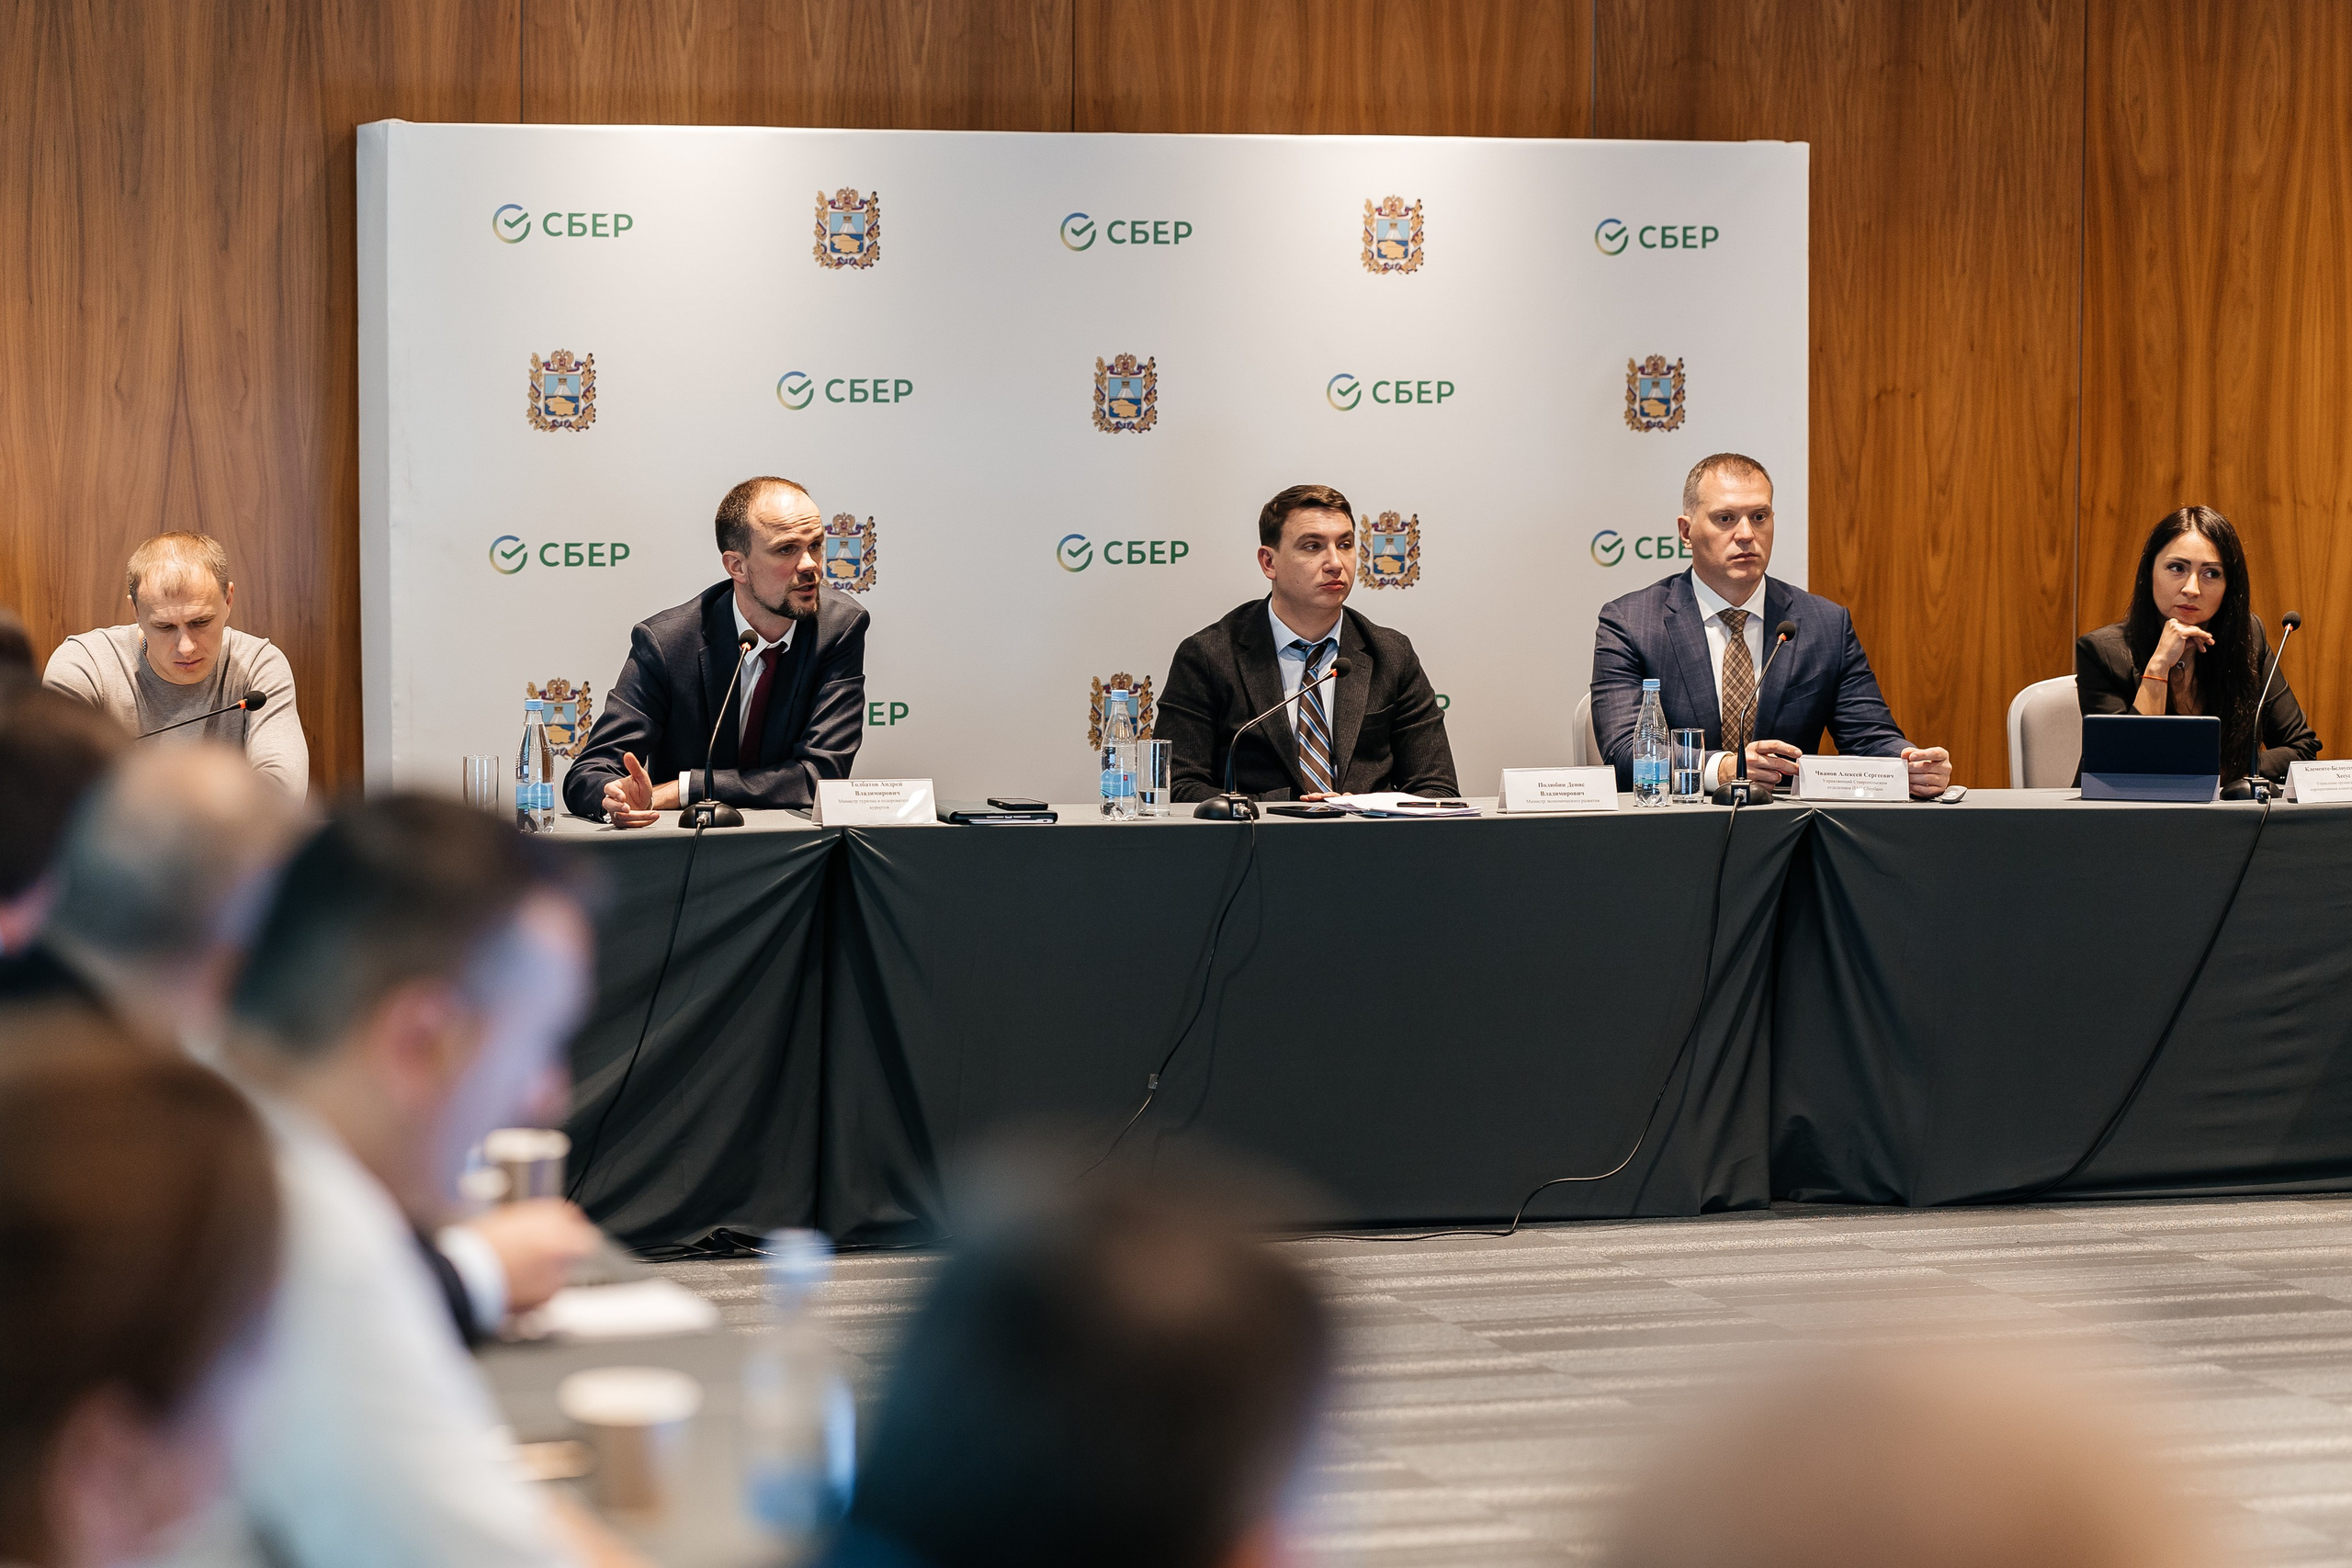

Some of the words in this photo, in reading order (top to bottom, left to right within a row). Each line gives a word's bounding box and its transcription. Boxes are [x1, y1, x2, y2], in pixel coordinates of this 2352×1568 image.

[543, 212, 632, 237] СБЕР
[1108, 220, 1193, 244] СБЕР
[1640, 226, 1718, 248] СБЕР
[826, 378, 913, 402] СБЕР
[1373, 381, 1454, 403] СБЕР
[539, 543, 630, 567] СБЕР
[1104, 541, 1189, 564] СБЕР
[1635, 536, 1693, 558] СБЕ
[868, 702, 909, 726] ЕР
